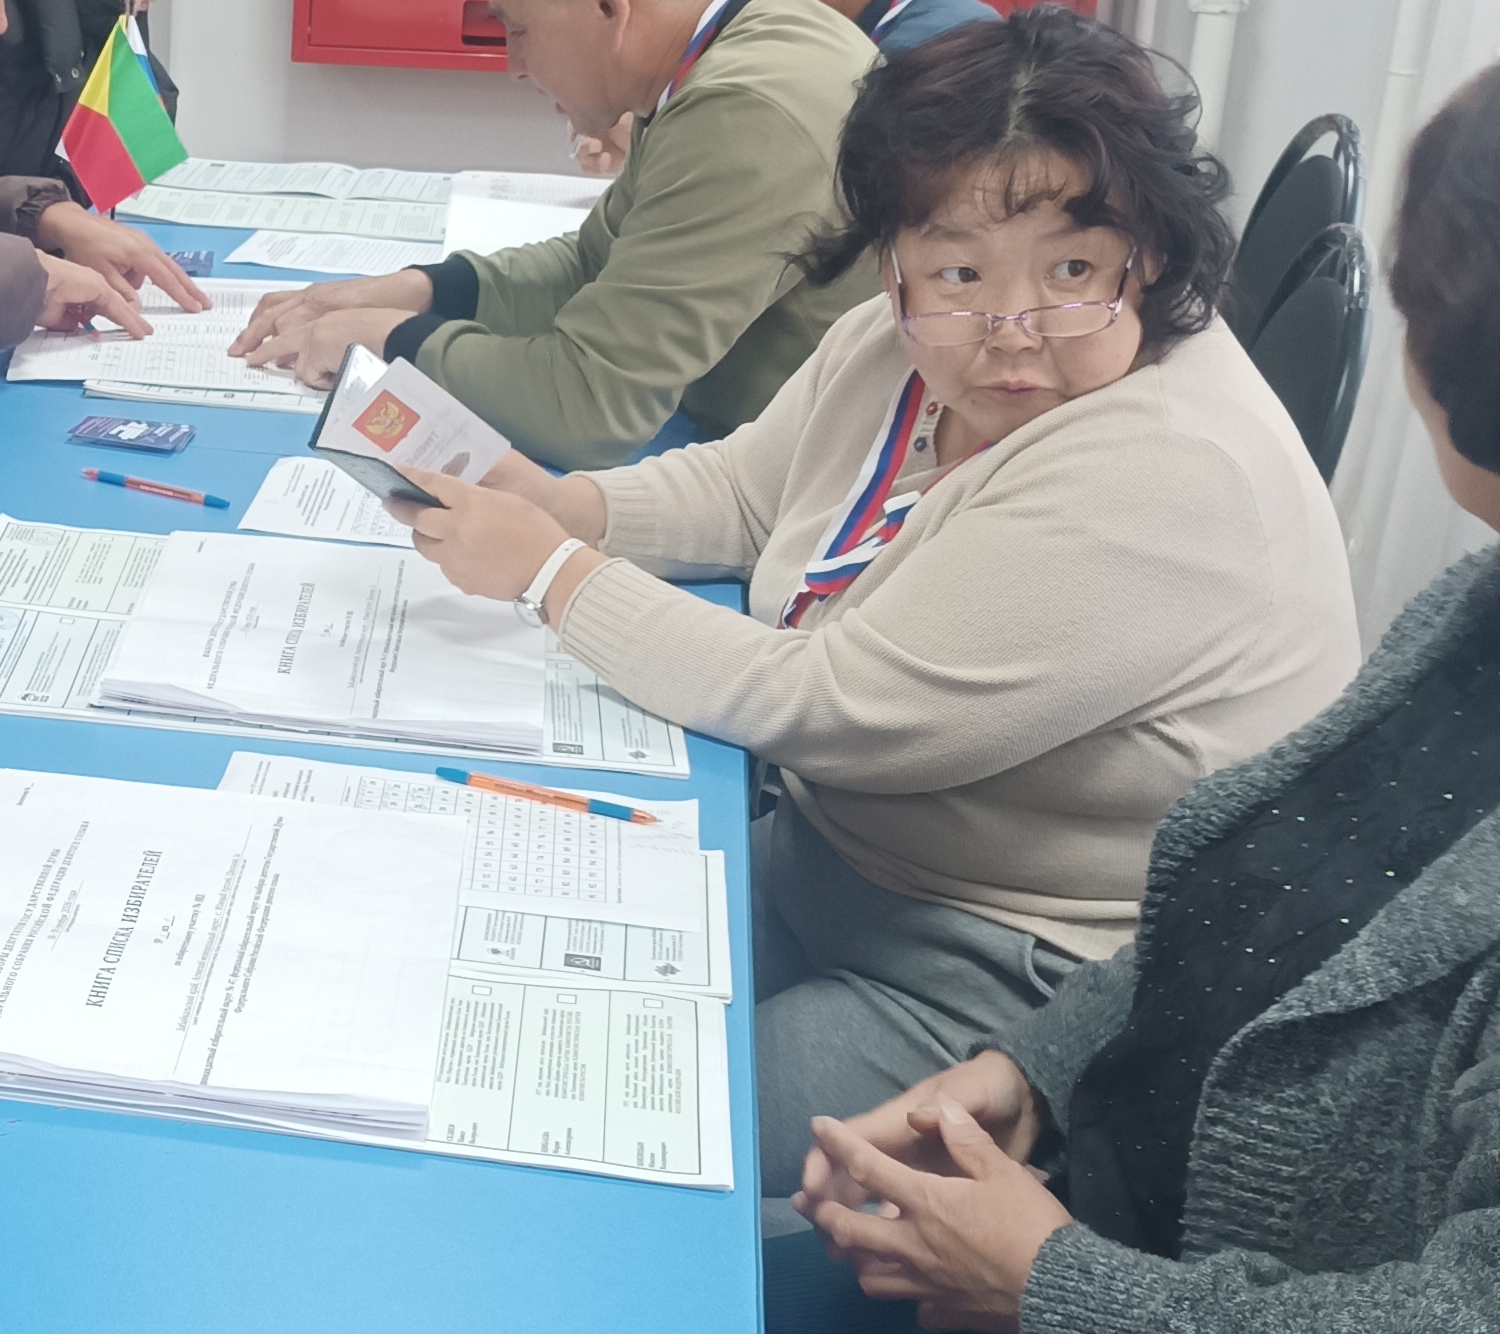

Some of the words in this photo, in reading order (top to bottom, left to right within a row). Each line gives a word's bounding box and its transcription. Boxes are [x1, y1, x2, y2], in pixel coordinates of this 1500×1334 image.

[277, 645, 296, 674] КНИГА
[291, 581, 314, 628] ИЗБИРАТЕЛЕЙ
[45, 866, 68, 901] ФЕДЕРАЦИИ
[117, 849, 162, 923] ИЗБИРАТЕЛЕЙ
[101, 924, 134, 964] СПИСКА
[84, 965, 117, 1007] КНИГА
